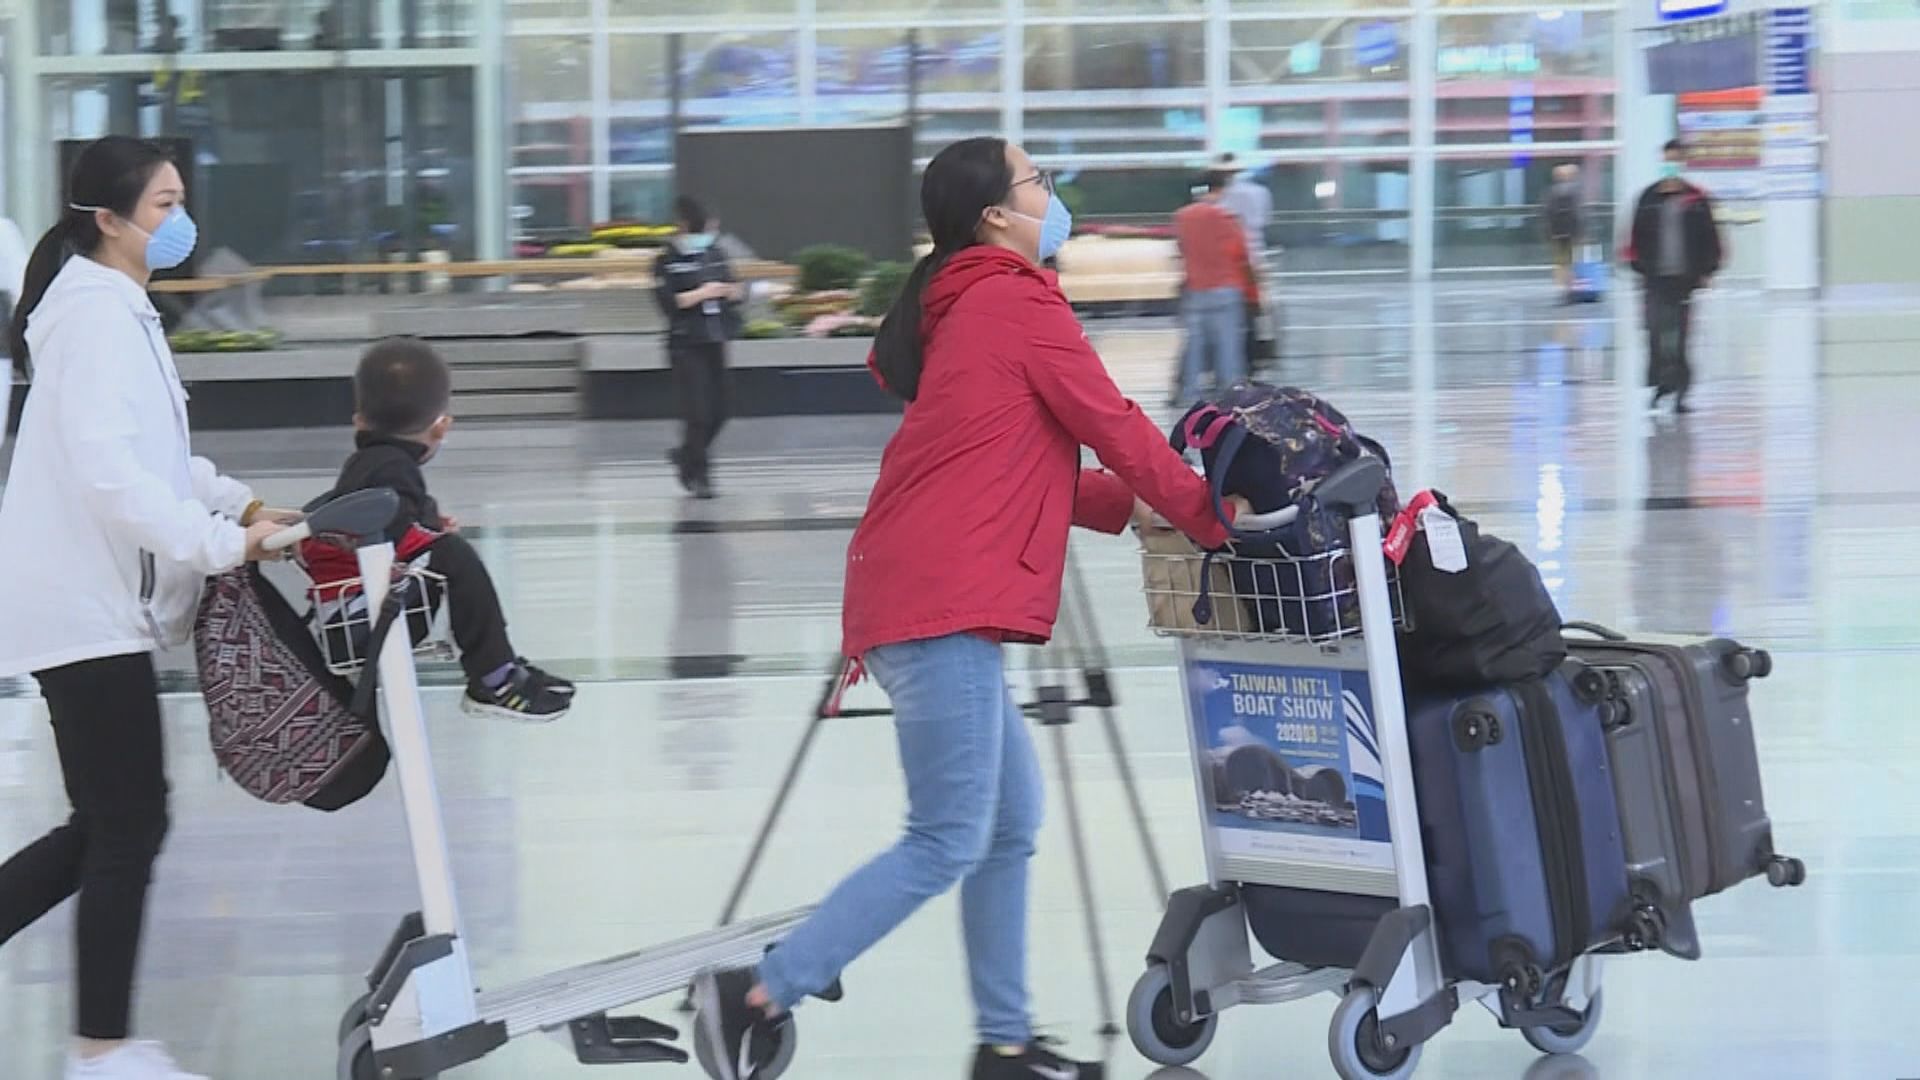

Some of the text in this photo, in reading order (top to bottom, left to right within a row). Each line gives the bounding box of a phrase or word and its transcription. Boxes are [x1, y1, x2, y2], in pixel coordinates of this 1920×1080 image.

[1230, 674, 1332, 697] TAIWAN INT'L
[1233, 694, 1333, 720] BOAT SHOW
